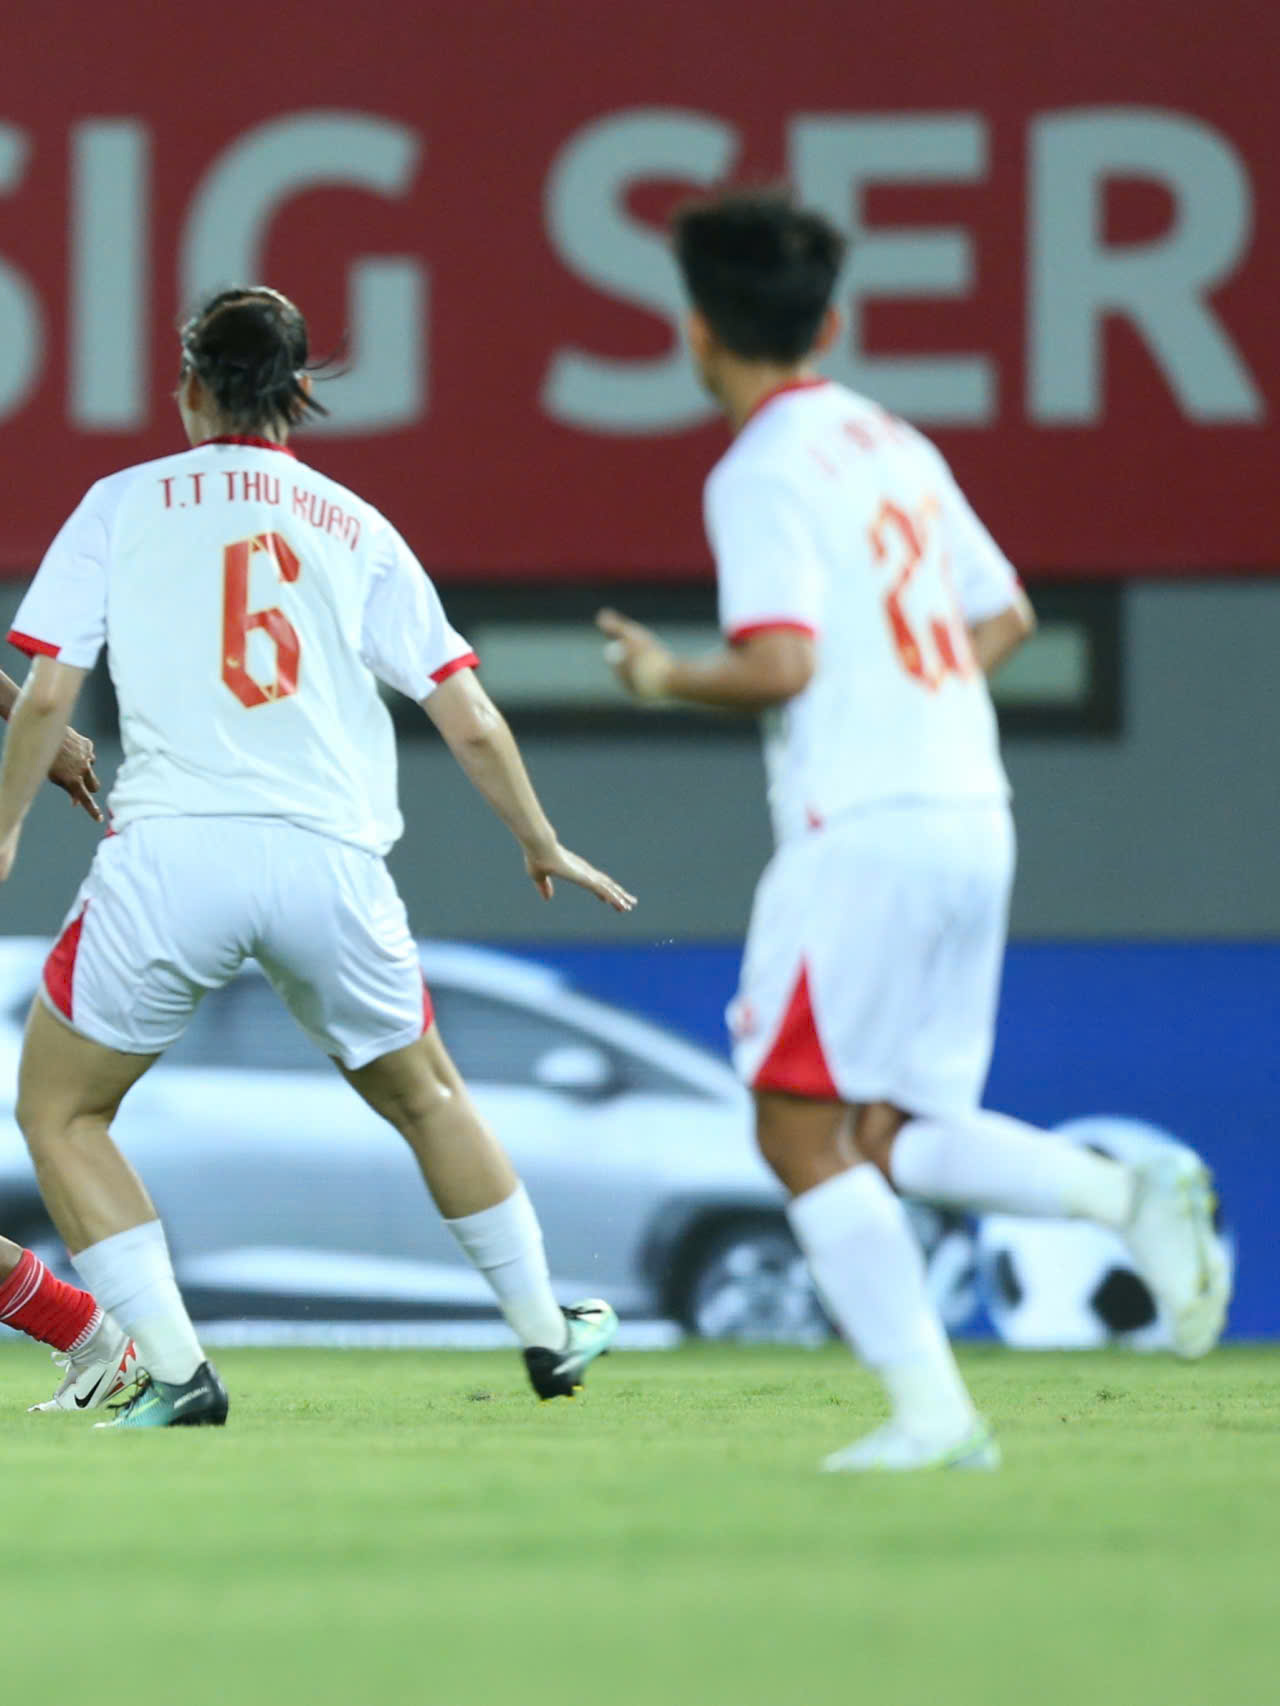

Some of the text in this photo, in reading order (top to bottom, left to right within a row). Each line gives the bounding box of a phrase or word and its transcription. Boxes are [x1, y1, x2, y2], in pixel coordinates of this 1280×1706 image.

[542, 106, 1265, 436] SER
[158, 472, 206, 508] T.T
[223, 471, 280, 505] THU
[221, 531, 301, 708] 6
